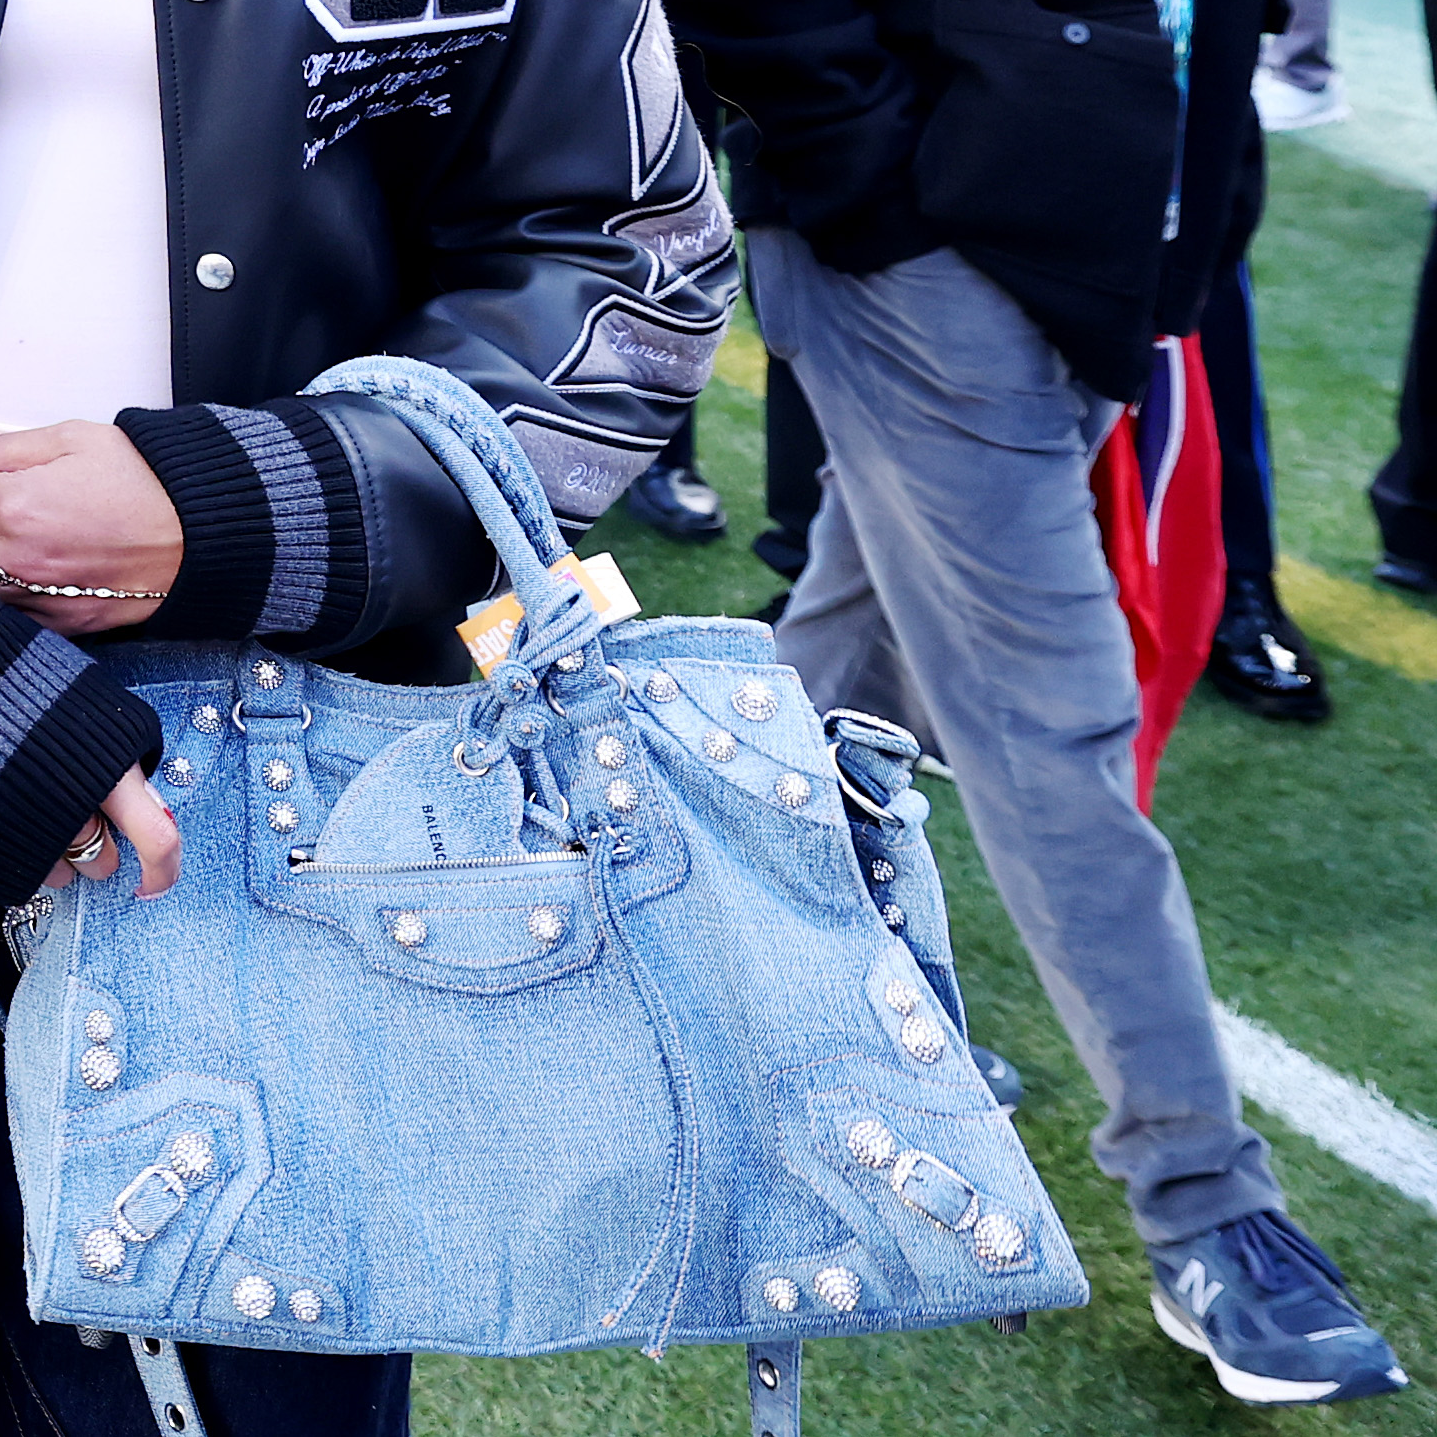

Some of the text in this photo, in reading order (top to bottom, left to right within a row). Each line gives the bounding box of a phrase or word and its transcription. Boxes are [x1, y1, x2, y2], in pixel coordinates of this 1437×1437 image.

[653, 207, 721, 259] Virgil
[610, 328, 678, 366] Lunar
[1175, 1257, 1225, 1317] N
